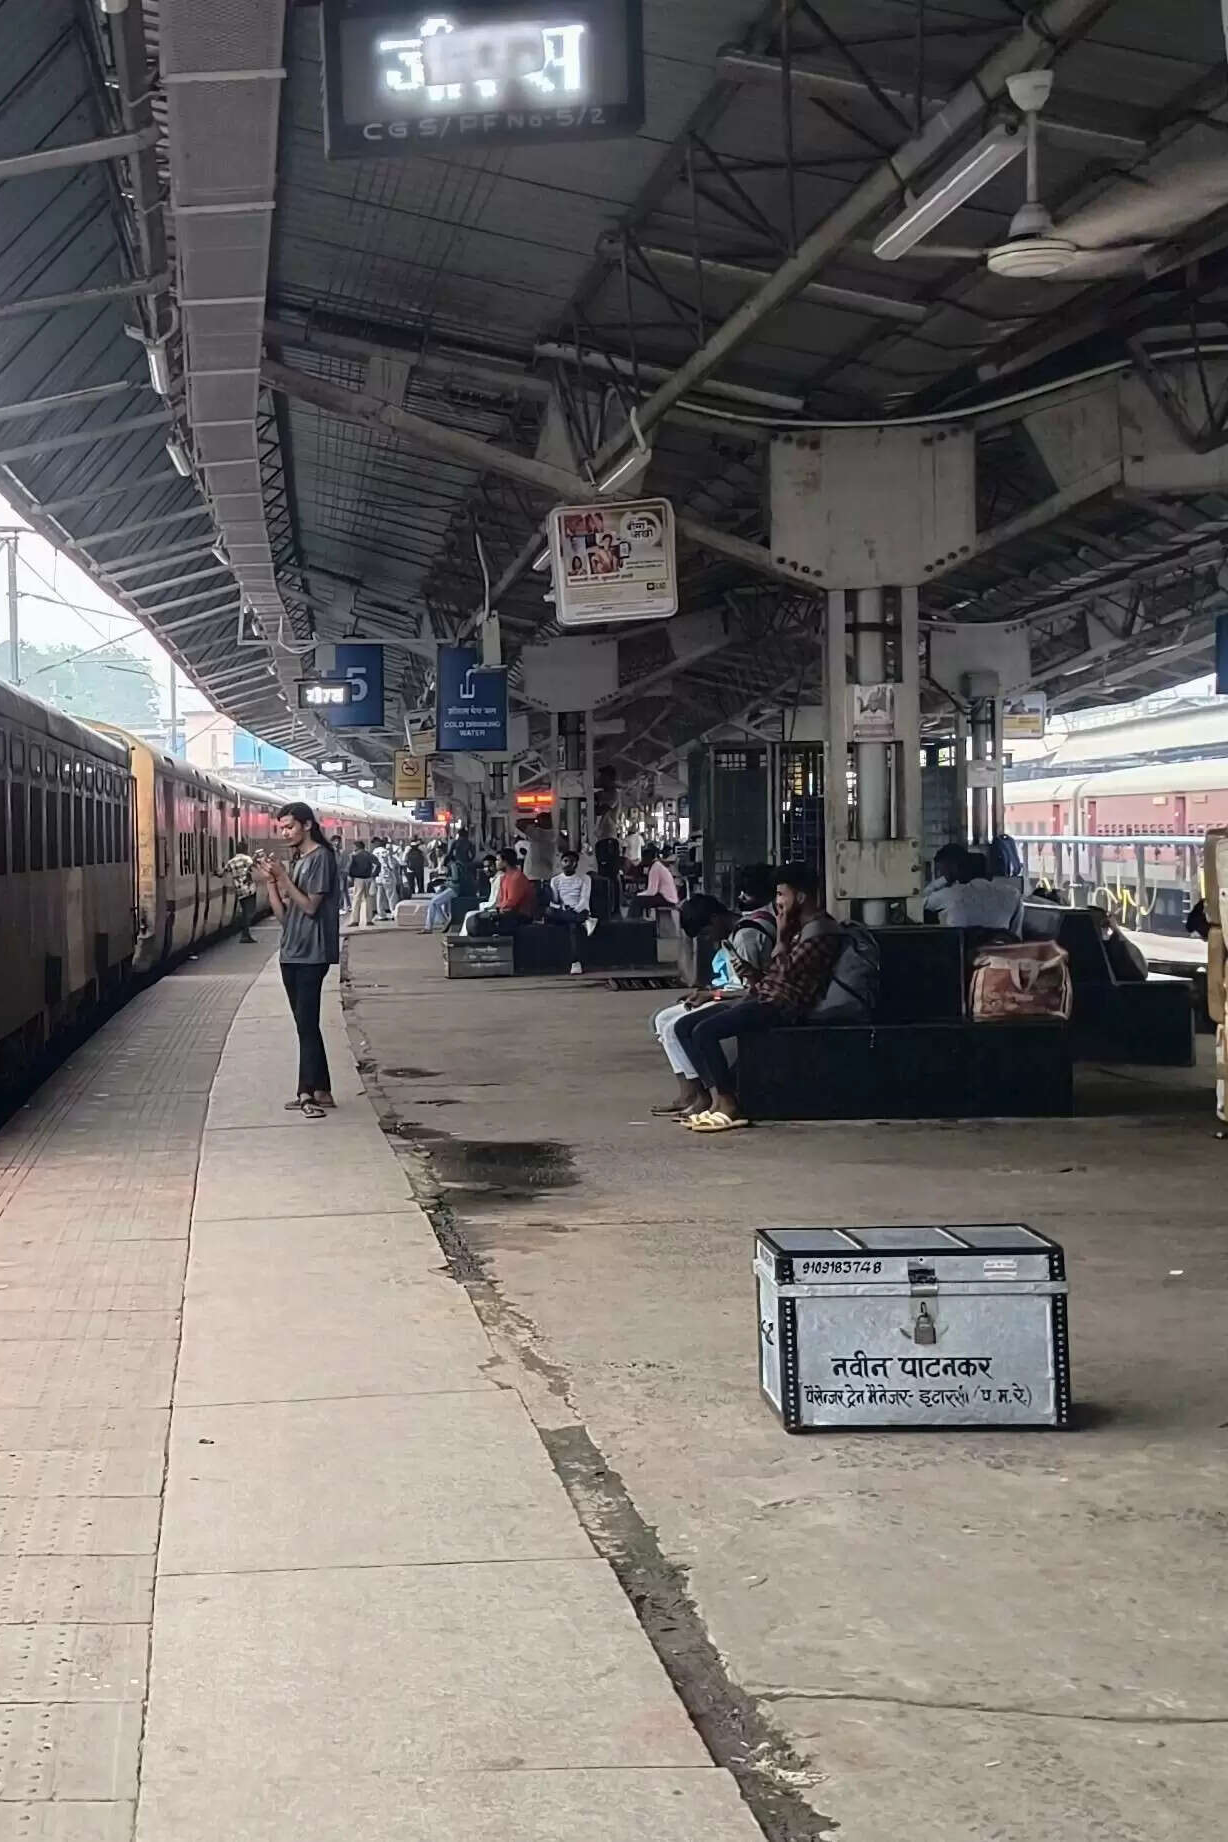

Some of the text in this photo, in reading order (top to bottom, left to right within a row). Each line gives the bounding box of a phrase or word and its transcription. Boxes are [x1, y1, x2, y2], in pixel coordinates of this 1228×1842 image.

[346, 667, 368, 702] 5
[443, 721, 464, 729] COLD
[459, 729, 485, 737] WATER
[831, 1349, 993, 1379] नवीन पाटनकर
[845, 1384, 865, 1409] ट्रेन
